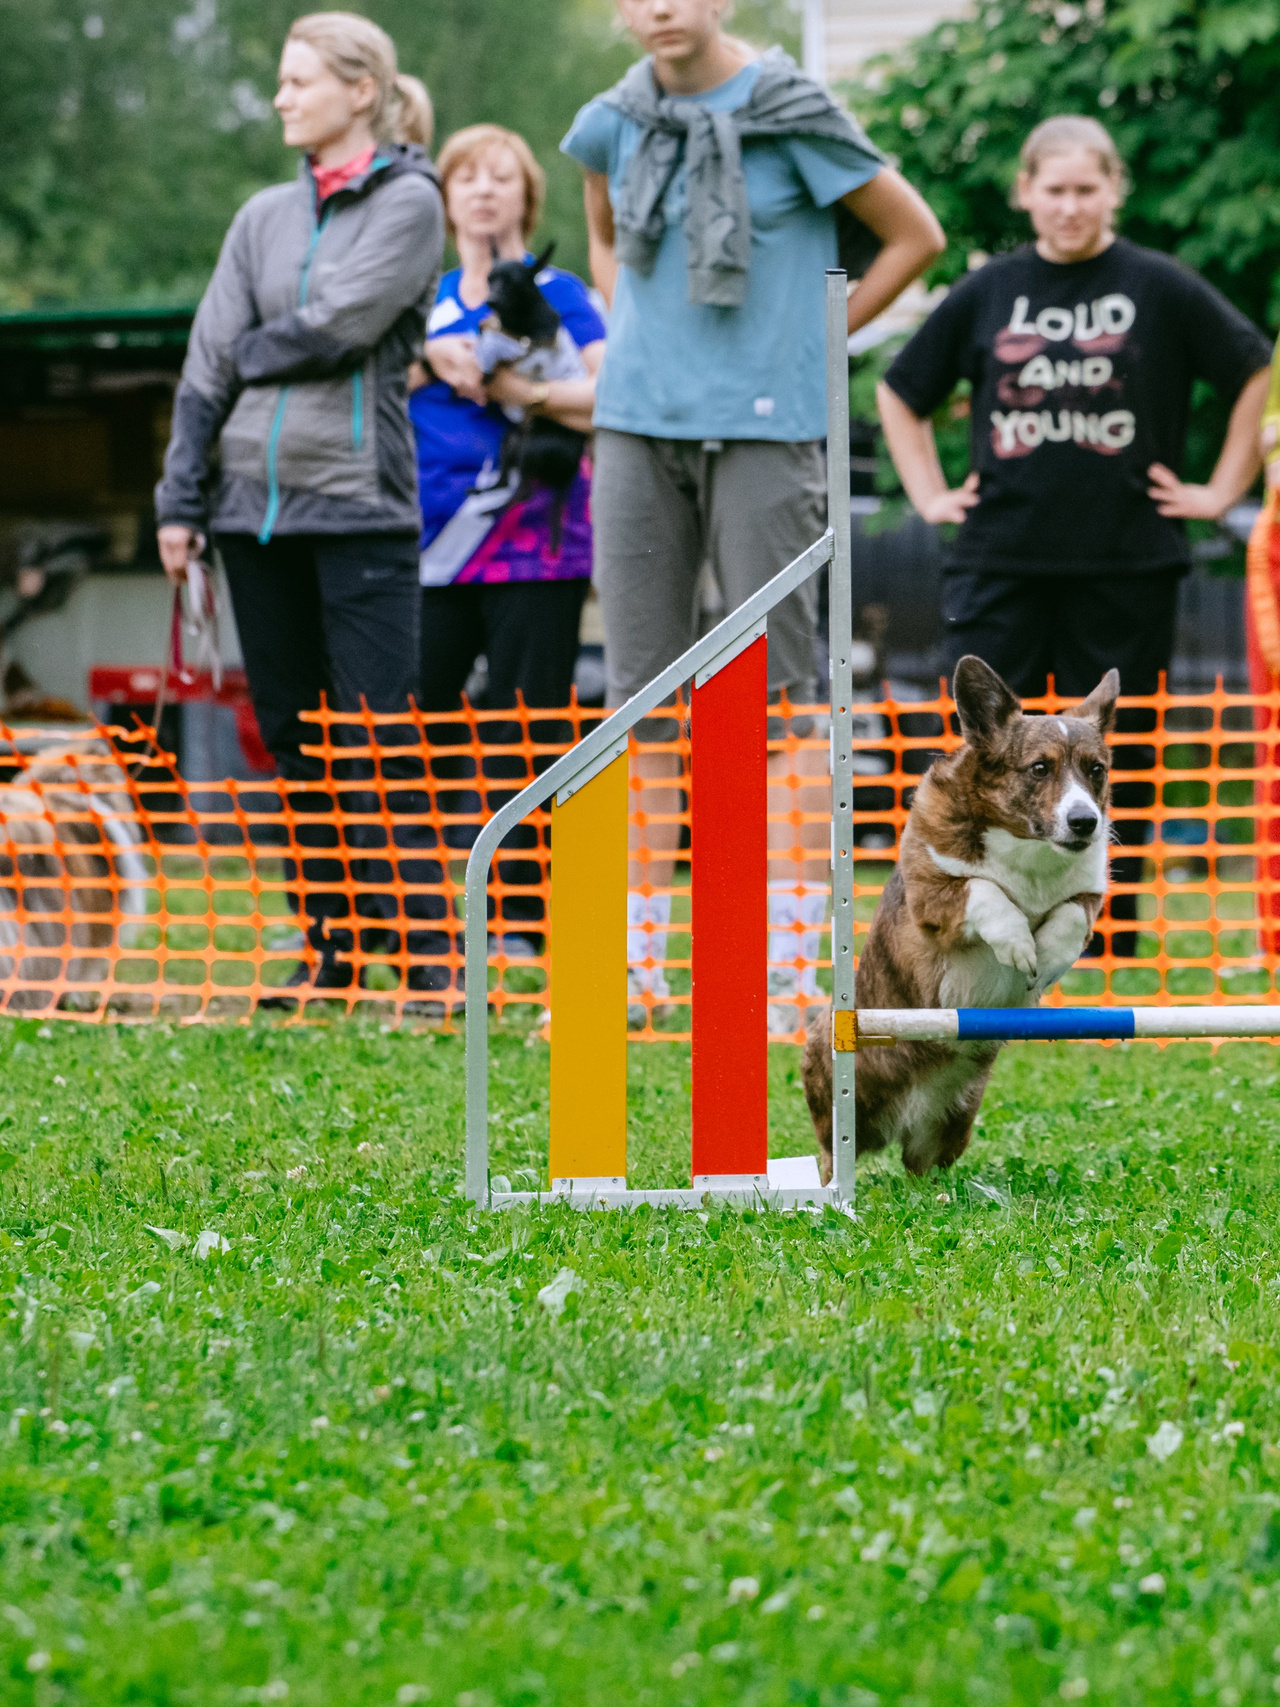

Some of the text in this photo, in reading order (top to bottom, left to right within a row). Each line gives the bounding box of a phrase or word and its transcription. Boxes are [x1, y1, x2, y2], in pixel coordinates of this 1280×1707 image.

[1008, 293, 1136, 342] LOUD
[1017, 355, 1113, 390] AND
[990, 409, 1136, 450] YOUNG
